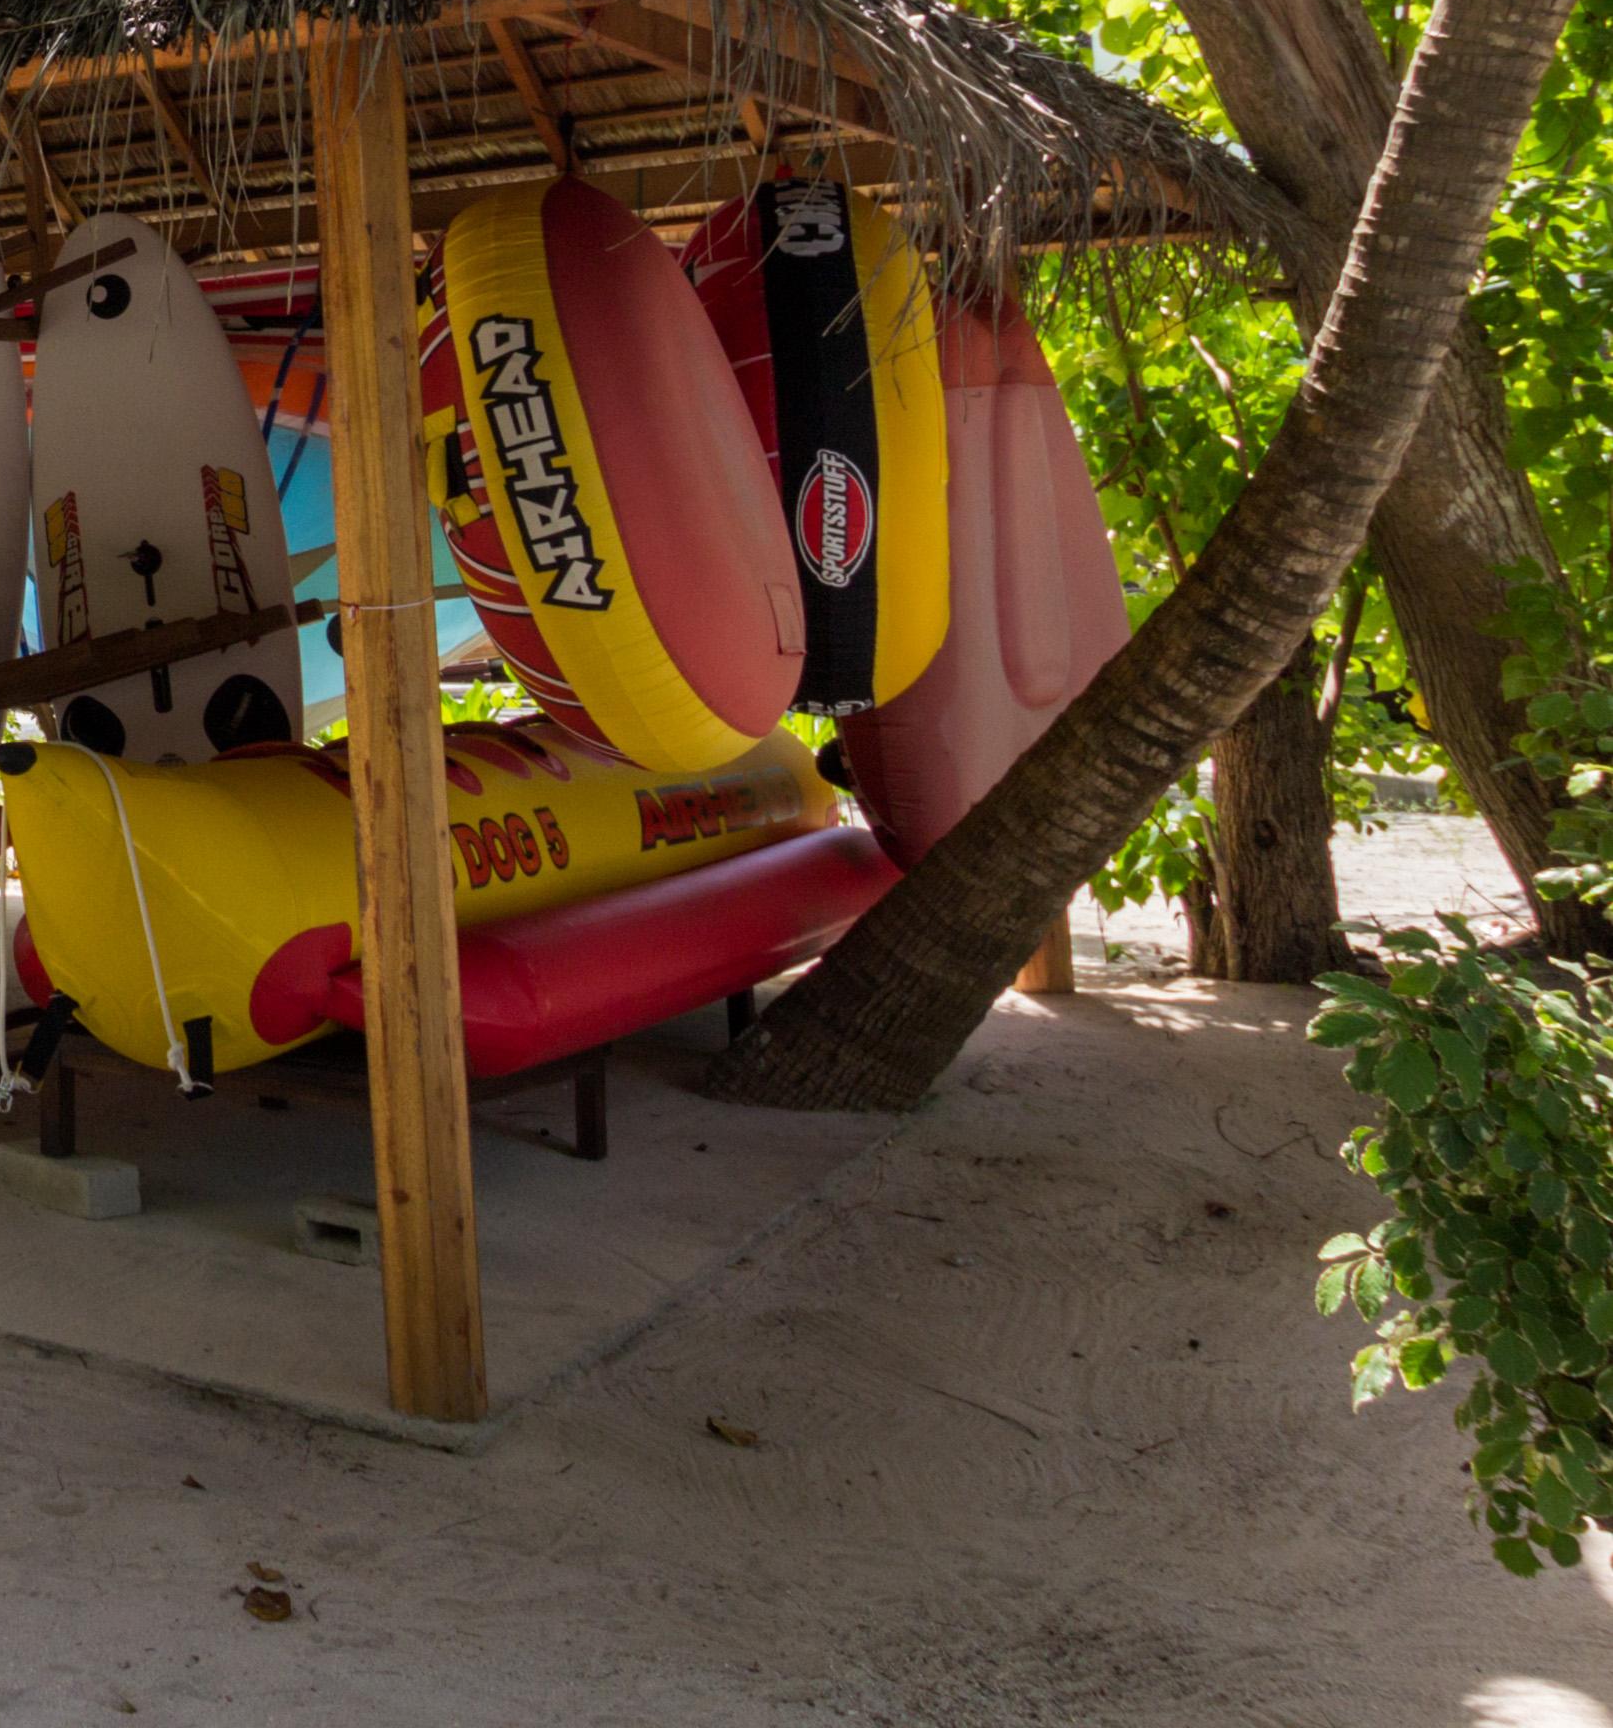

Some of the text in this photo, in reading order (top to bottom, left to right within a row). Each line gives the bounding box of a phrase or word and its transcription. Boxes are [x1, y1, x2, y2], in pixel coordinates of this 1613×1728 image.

[470, 315, 612, 610] AIRHEAD
[822, 452, 848, 585] SPORTSSTUFF
[450, 812, 542, 889] DOG
[533, 806, 569, 870] 5
